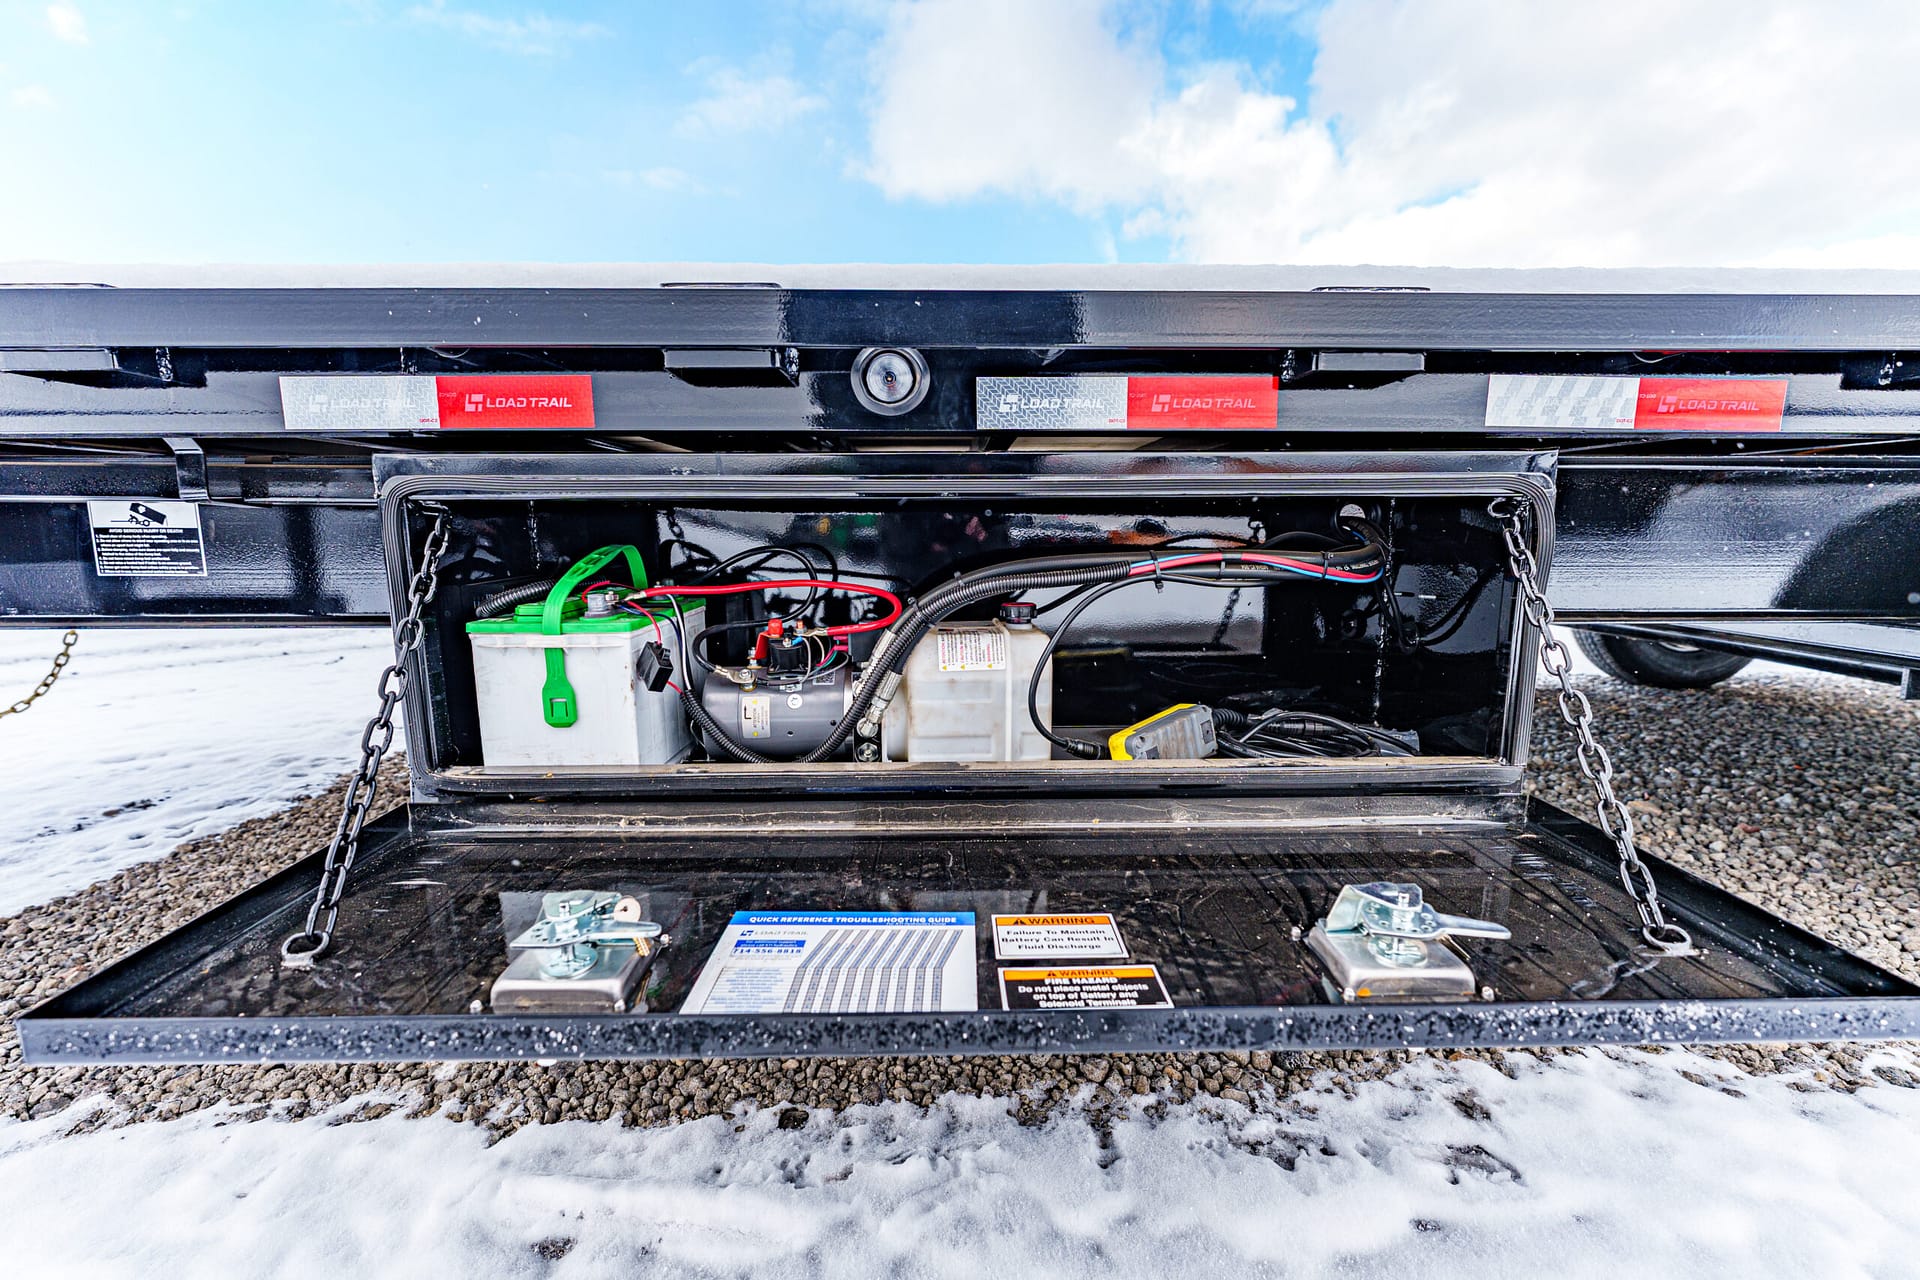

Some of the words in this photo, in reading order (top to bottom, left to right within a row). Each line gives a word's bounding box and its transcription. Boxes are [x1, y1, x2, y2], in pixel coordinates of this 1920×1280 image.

[486, 397, 527, 408] LOAD
[530, 396, 572, 408] TRAIL
[1020, 398, 1061, 409] LOAD
[1063, 398, 1104, 408] TRAIL
[1173, 397, 1212, 408] LOAD
[1215, 397, 1256, 408] TRAIL
[1678, 399, 1718, 410] LOAD
[1720, 400, 1760, 411] TRAIL
[749, 916, 779, 924] QUICK
[1028, 917, 1095, 925] WARNING
[1034, 985, 1051, 993] not
[1054, 985, 1081, 994] place
[1111, 983, 1149, 992] objects
[1048, 993, 1066, 1001] top
[1080, 992, 1116, 1000] Battery
[1117, 991, 1139, 999] and
[1086, 999, 1137, 1007] Terminals
